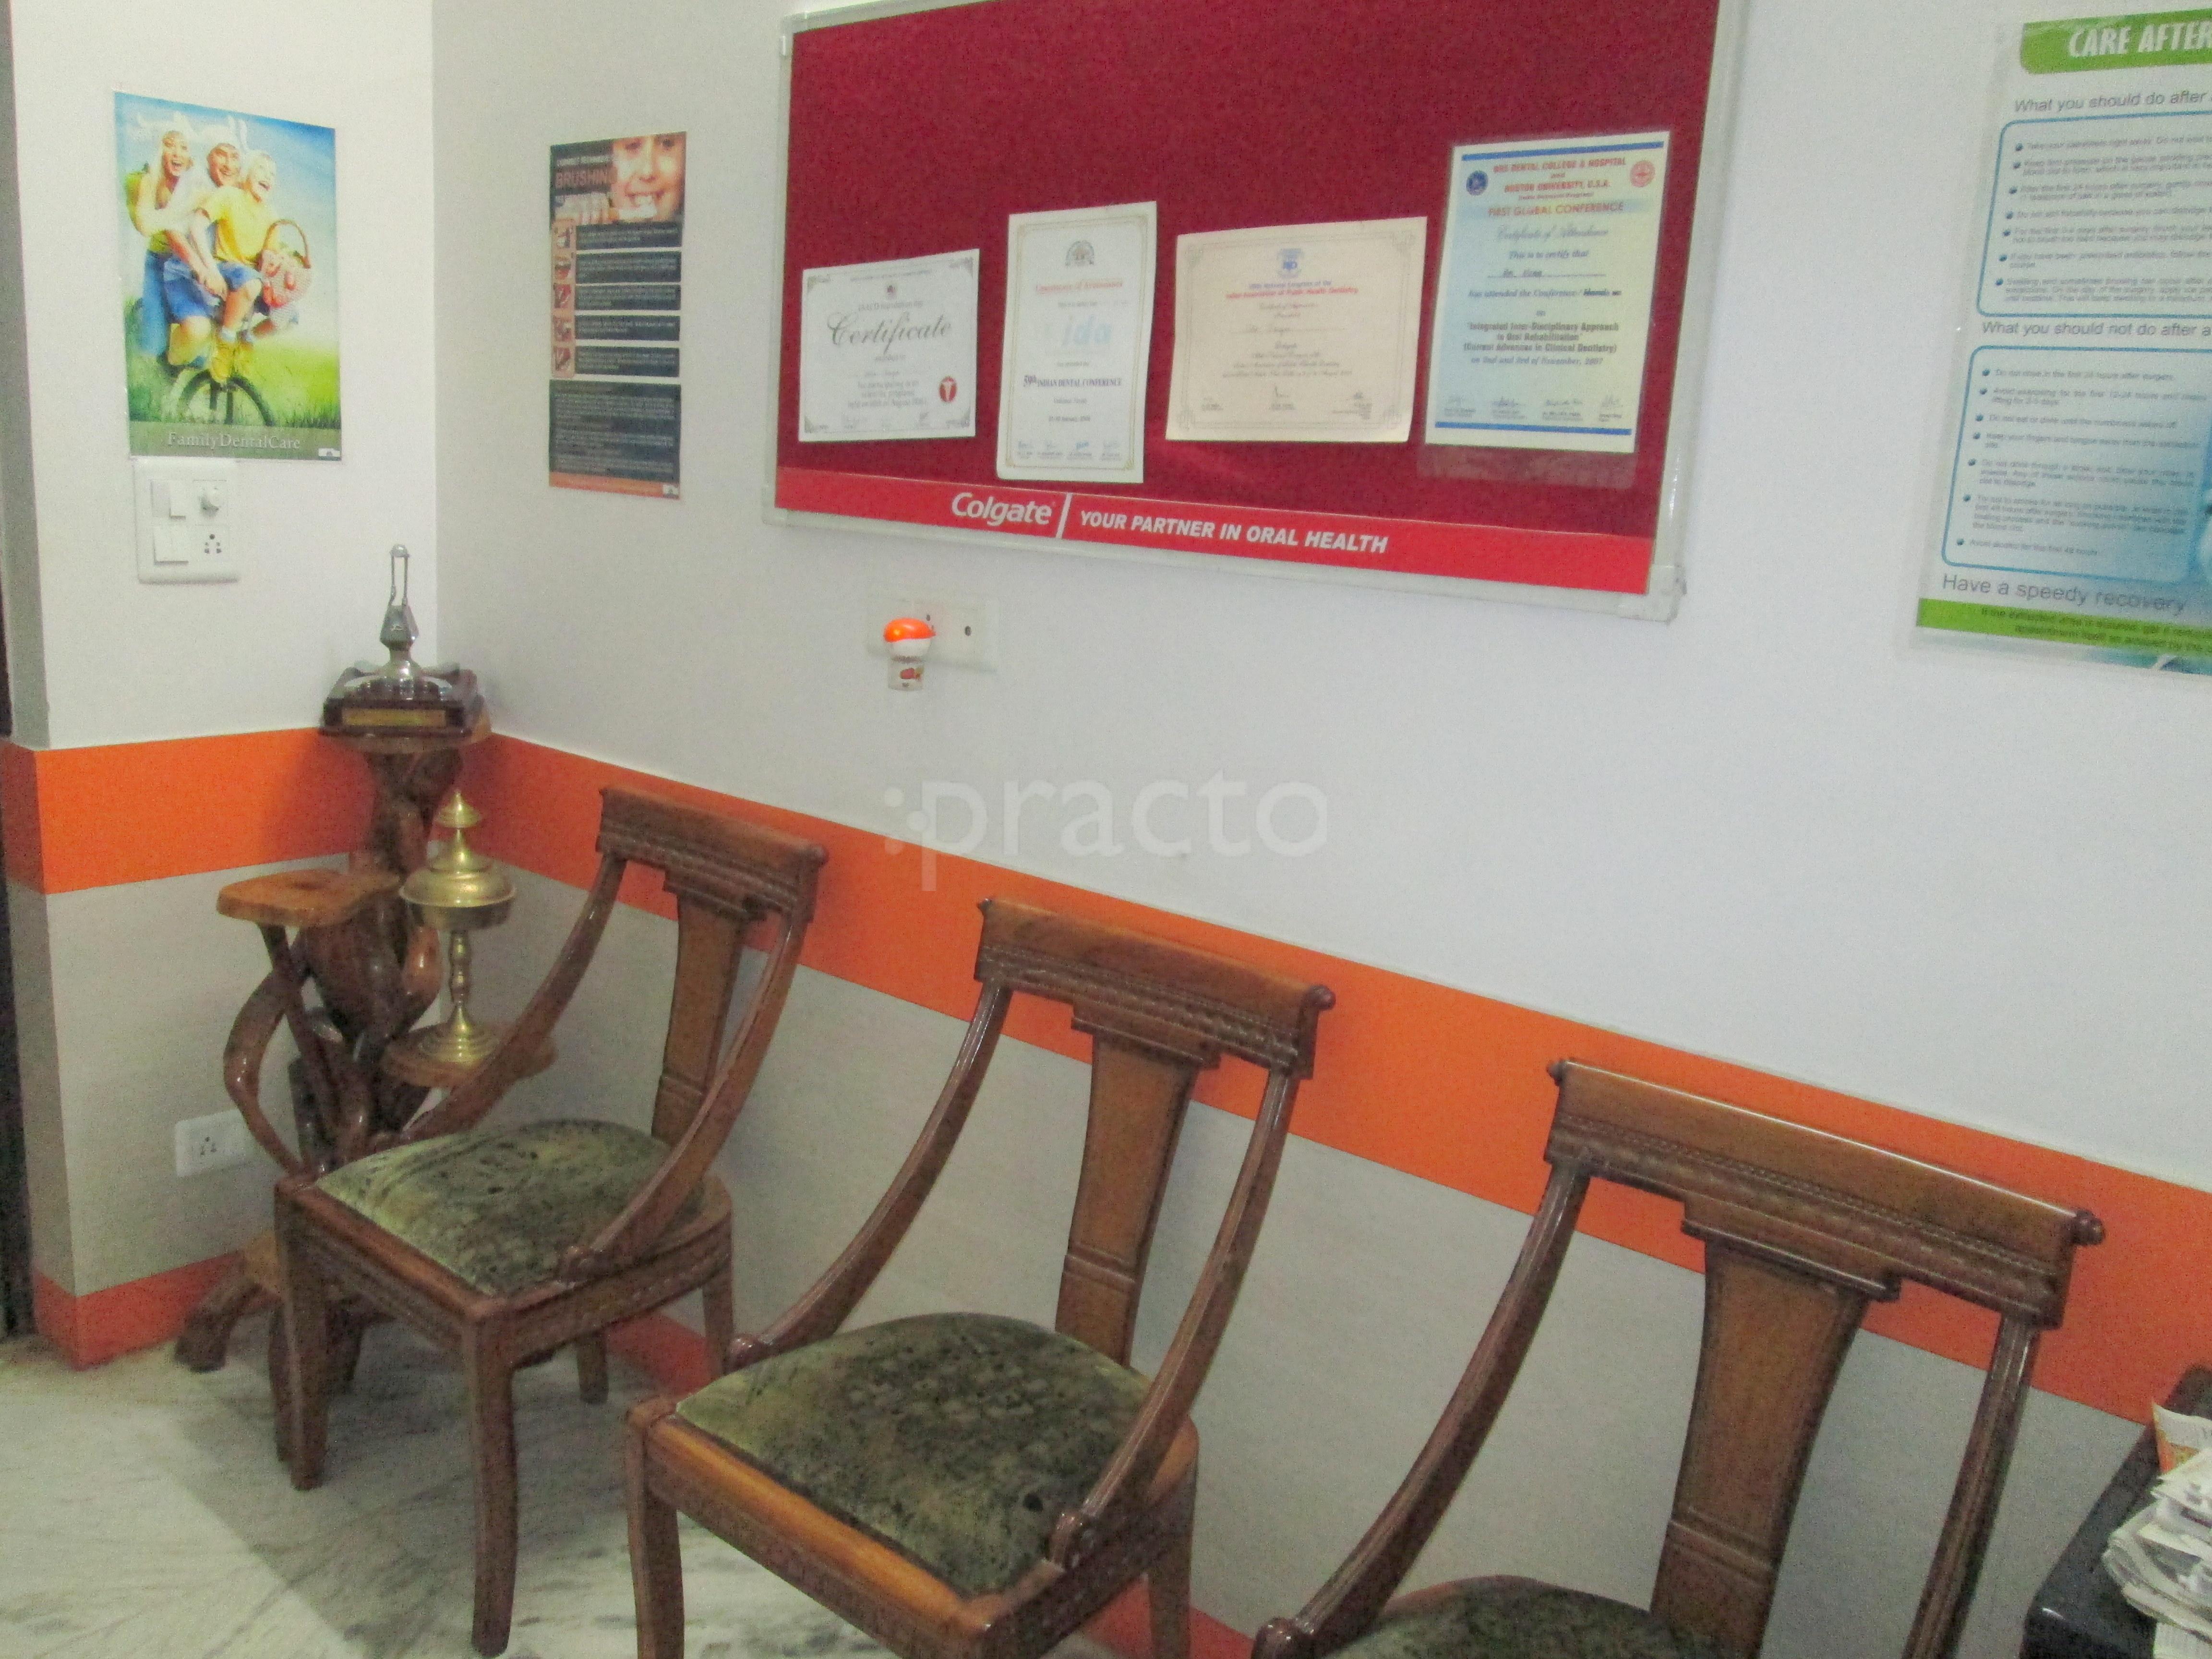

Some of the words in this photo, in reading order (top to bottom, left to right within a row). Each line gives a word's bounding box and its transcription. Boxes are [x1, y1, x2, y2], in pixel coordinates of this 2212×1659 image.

[2068, 26, 2131, 57] CARE
[2139, 22, 2212, 52] AFTER
[2014, 97, 2052, 112] What
[2056, 98, 2084, 112] you
[2089, 93, 2140, 108] should
[2145, 92, 2165, 105] do
[2170, 90, 2207, 104] after
[1555, 201, 1624, 215] CONFERENCE
[827, 312, 952, 355] Certificate
[1982, 322, 2019, 336] What
[2023, 323, 2049, 337] you
[2054, 322, 2104, 335] should
[2109, 323, 2132, 335] not
[2137, 323, 2157, 336] do
[2161, 324, 2197, 336] after
[1082, 377, 1122, 387] CONFERENCE
[951, 492, 1052, 524] Colgate
[1081, 510, 1128, 530] YOUR
[1131, 514, 1215, 539] PARTNER
[1220, 522, 1242, 541] IN
[1247, 526, 1298, 546] ORAL
[1304, 531, 1389, 553] HEALTH
[1942, 574, 1991, 594] Have
[1997, 582, 2009, 595] a
[2016, 583, 2089, 607] speedy
[2095, 591, 2188, 616] recovery
